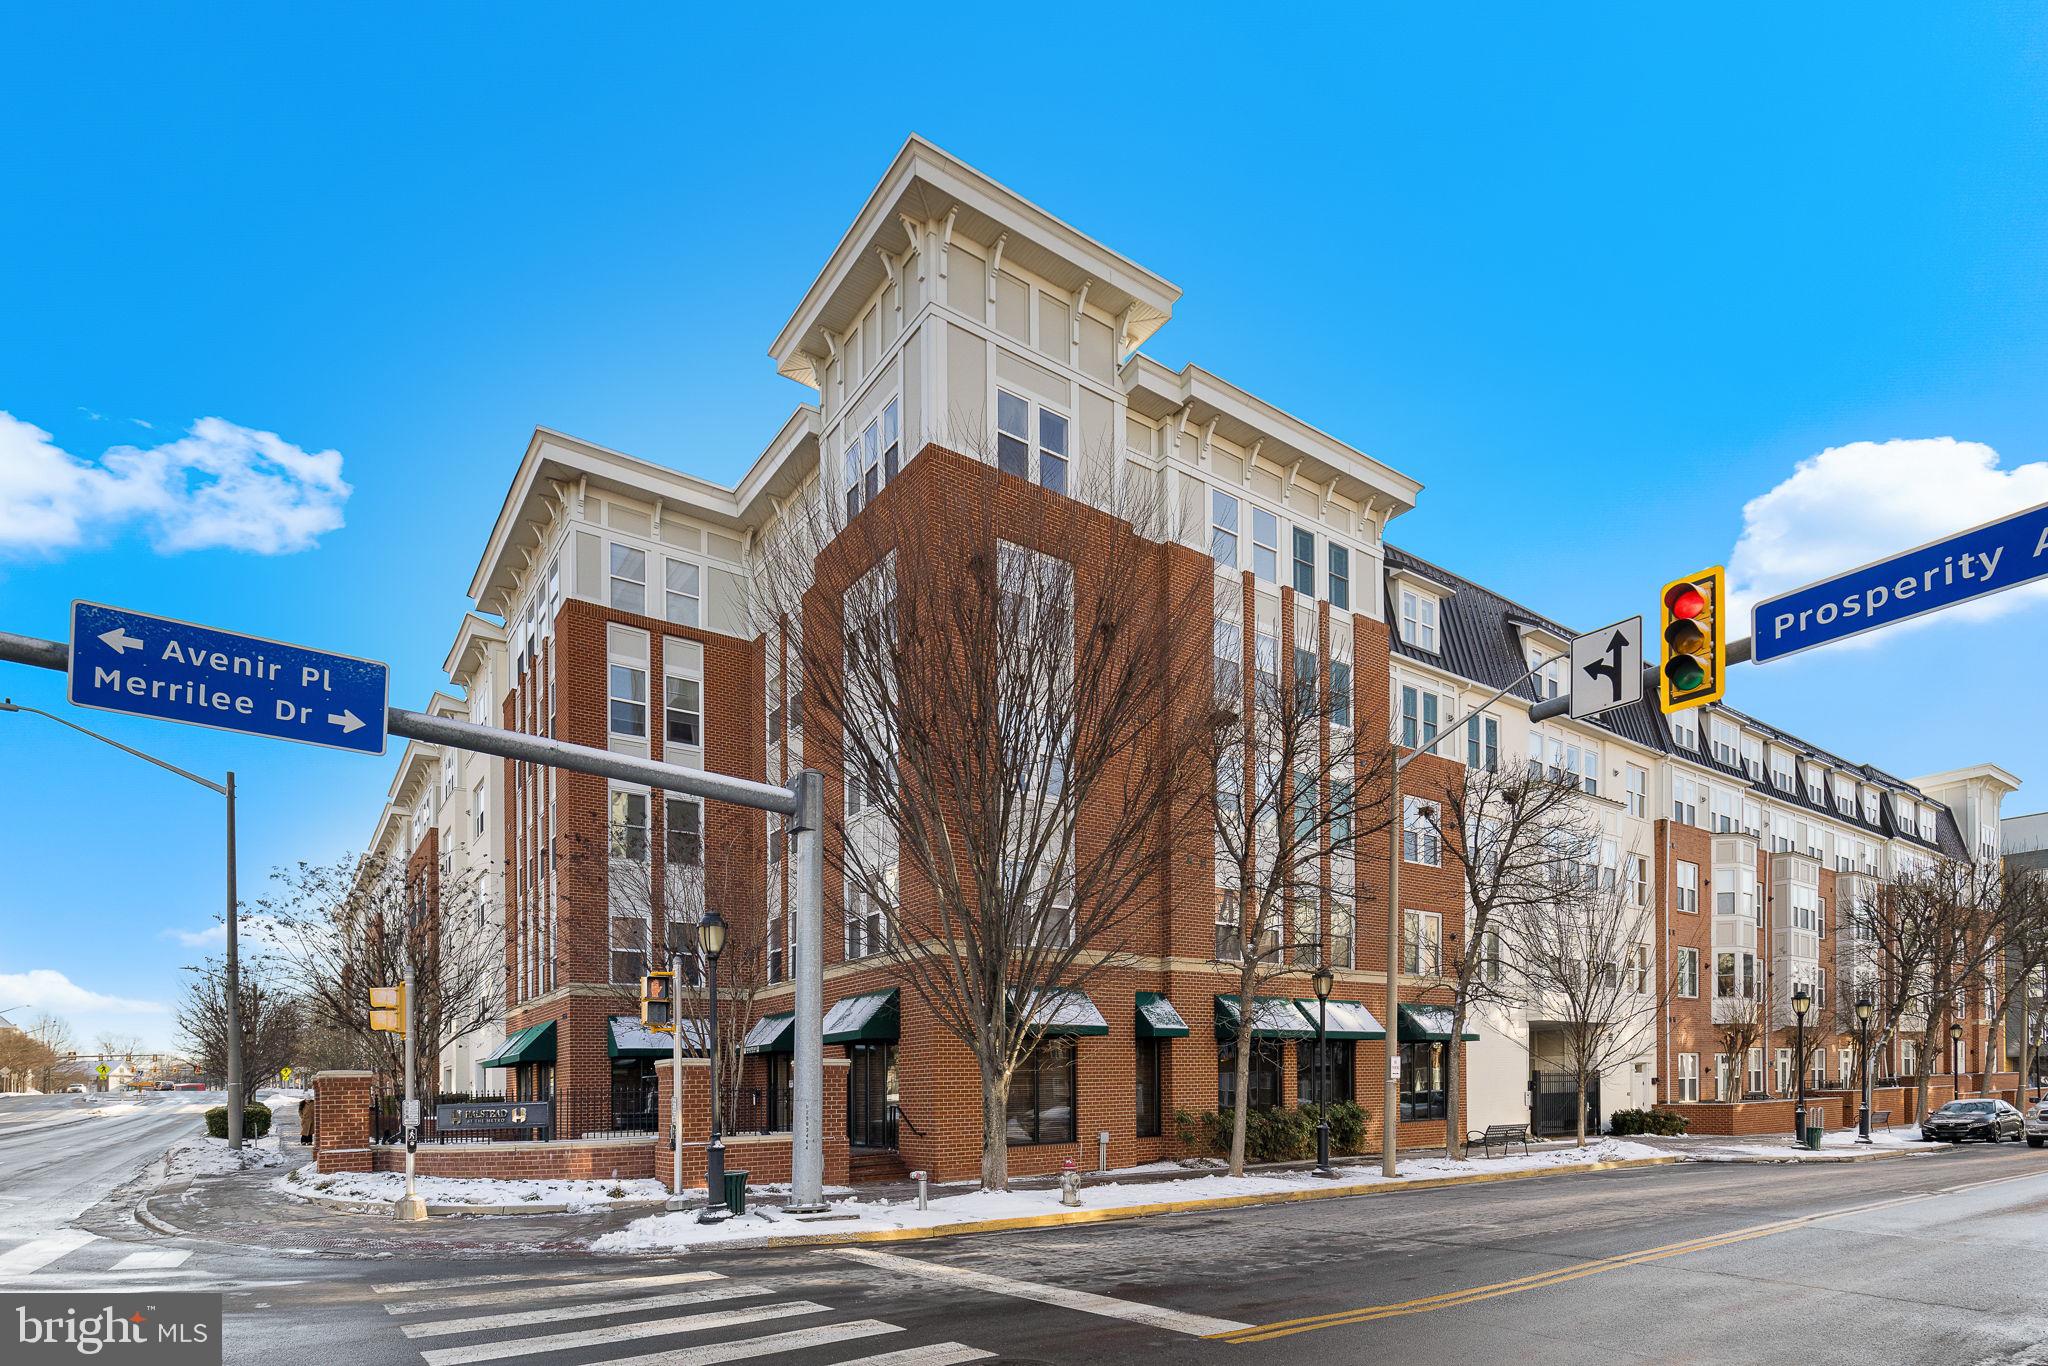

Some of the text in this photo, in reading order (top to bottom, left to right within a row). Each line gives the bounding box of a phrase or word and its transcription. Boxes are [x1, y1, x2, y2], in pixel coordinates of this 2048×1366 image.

[1774, 546, 2004, 639] Prosperity
[162, 640, 332, 692] Avenir Pl
[94, 666, 312, 724] Merrilee Dr
[464, 1108, 508, 1119] HALSTEAD
